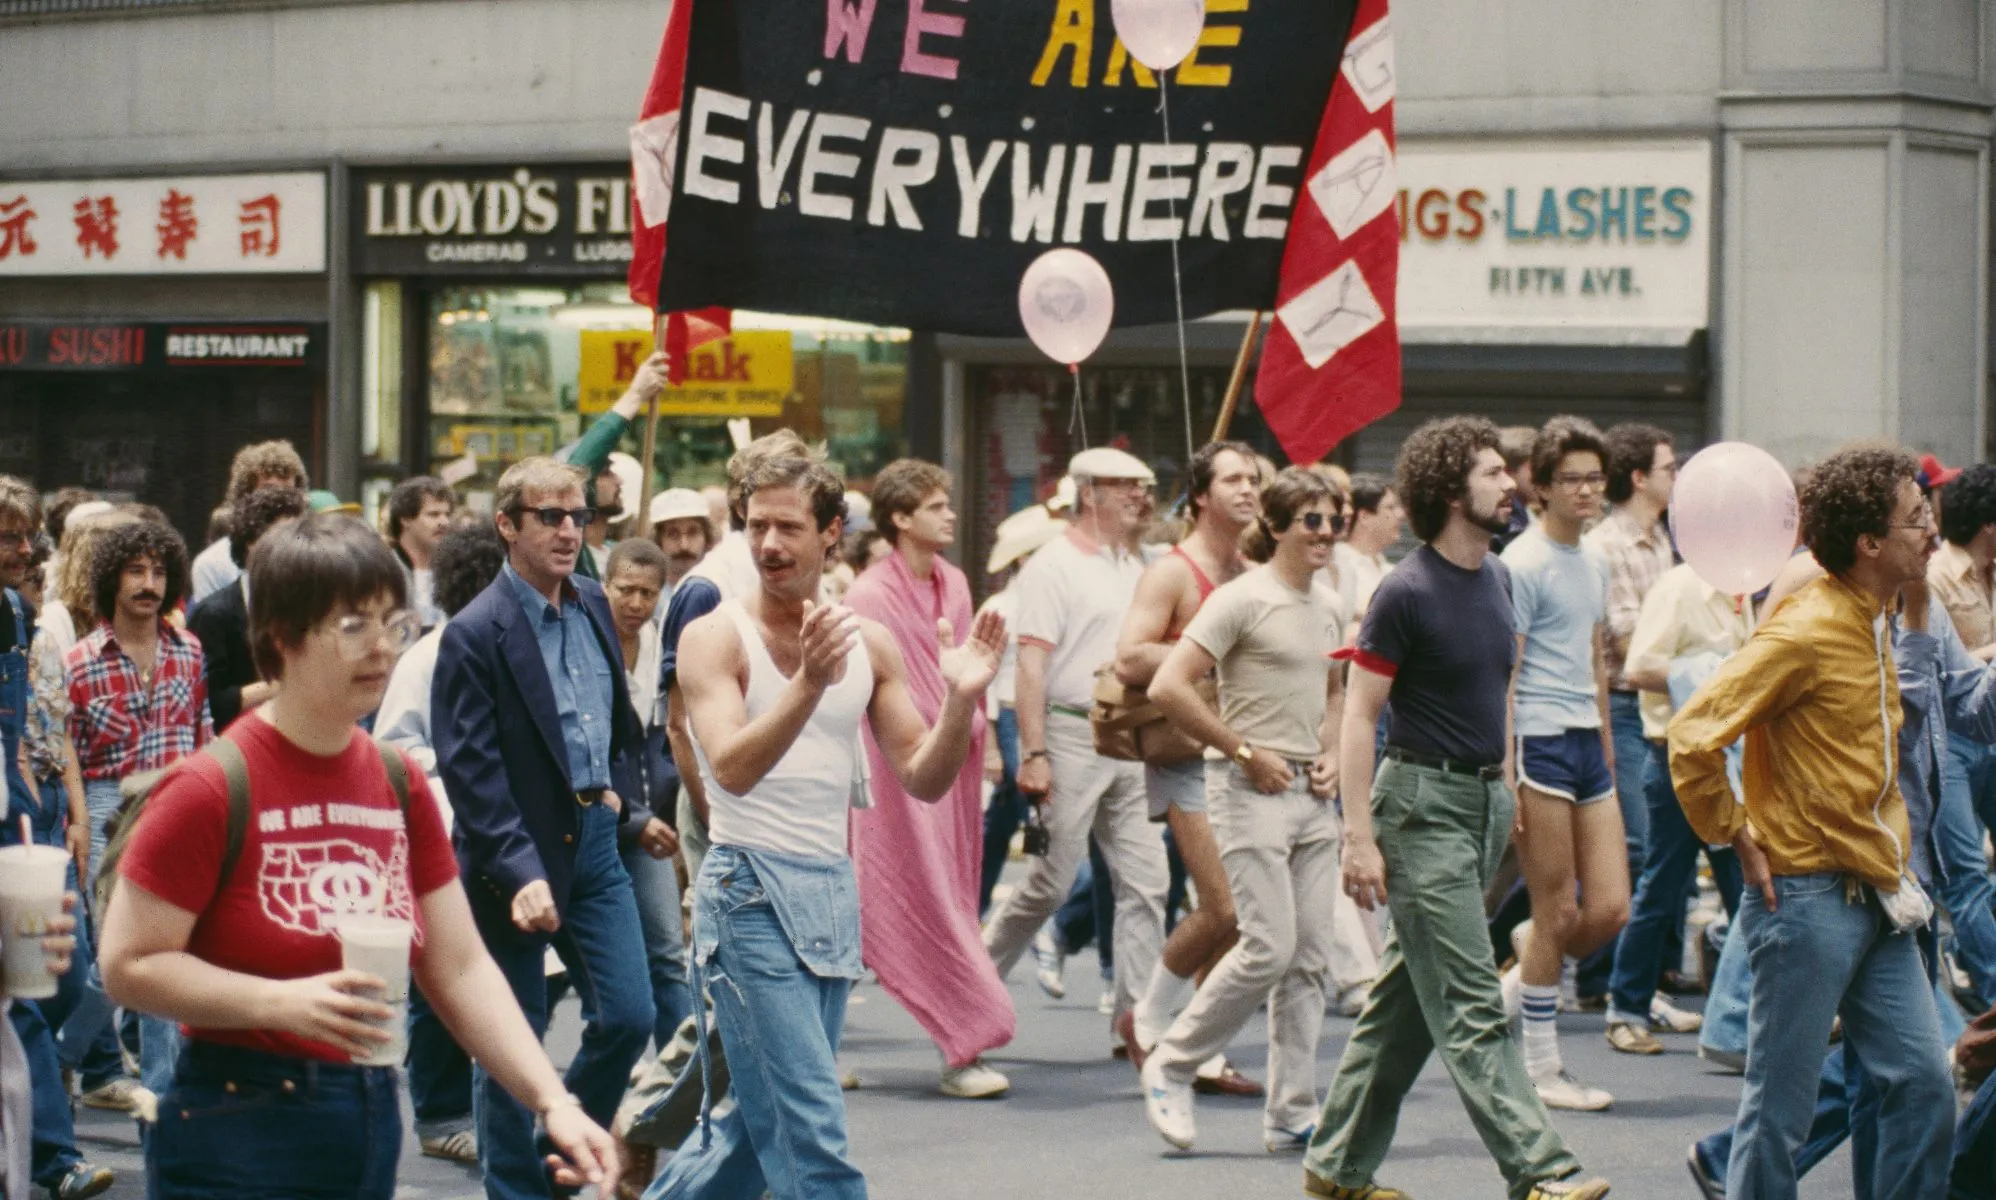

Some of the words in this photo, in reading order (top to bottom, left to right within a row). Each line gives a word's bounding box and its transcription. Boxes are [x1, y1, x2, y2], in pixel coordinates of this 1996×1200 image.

[823, 0, 968, 80] WE
[683, 87, 1302, 243] EVERYWHERE
[367, 168, 559, 236] LLOYD'S
[1506, 186, 1694, 241] LASHES
[426, 242, 528, 262] CAMERAS
[1489, 266, 1565, 294] FIFTH
[48, 328, 145, 366] SUSHI
[166, 334, 309, 358] RESTAURANT
